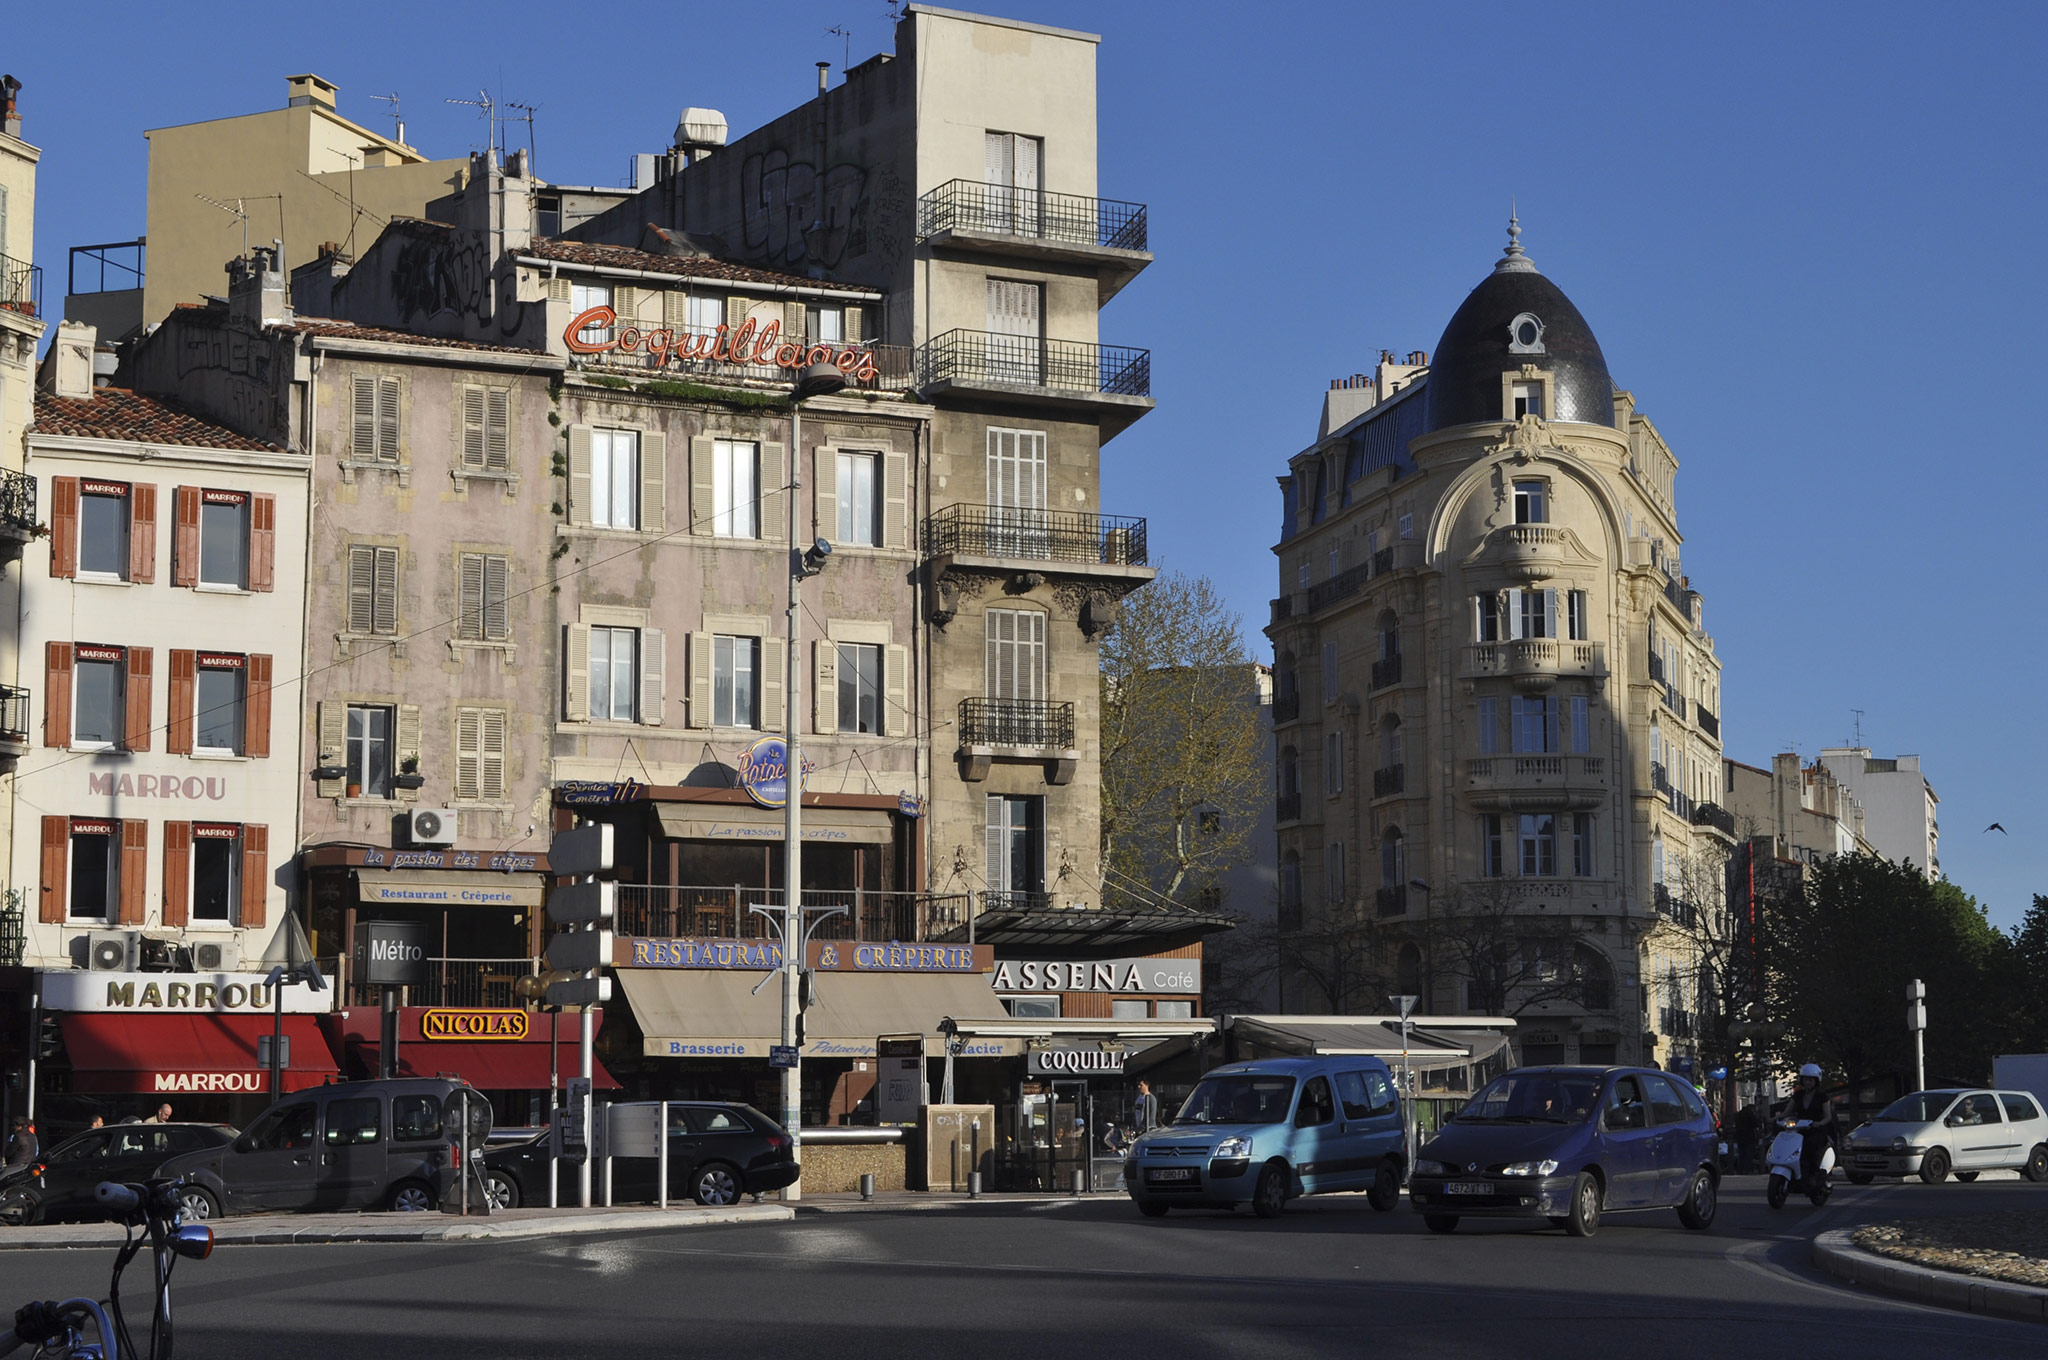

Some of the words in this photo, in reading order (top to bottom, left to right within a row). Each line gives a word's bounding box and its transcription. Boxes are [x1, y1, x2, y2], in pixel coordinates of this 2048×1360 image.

[562, 304, 880, 382] Coquillages
[85, 482, 125, 495] MARROU
[206, 491, 243, 503] MARROU
[79, 649, 119, 660] MARROU
[202, 656, 241, 667] MARROU
[89, 772, 226, 800] MARROU
[613, 778, 640, 801] 7/7
[74, 824, 114, 834] MARROU
[197, 828, 236, 838] MARROU
[709, 823, 732, 837] La
[736, 826, 782, 838] passion
[808, 828, 847, 840] crêpes
[365, 849, 384, 864] La
[392, 851, 443, 869] passion
[454, 851, 479, 866] des
[489, 852, 536, 873] crêpes
[381, 888, 448, 900] Restaurant
[461, 890, 512, 903] Crêperie
[372, 939, 422, 961] Métro
[635, 942, 783, 966] RESTAURAN
[821, 946, 839, 967] &
[854, 942, 973, 969] CRÊPERIE
[991, 961, 1146, 990] ASSENA
[1154, 971, 1194, 989] Café
[106, 981, 273, 1009] MARROU
[430, 1015, 524, 1035] NICOLAS
[669, 1041, 745, 1055] Brasserie
[809, 1041, 878, 1054] Patacrêp
[1039, 1050, 1139, 1073] COQUILLA
[155, 1073, 260, 1092] MARROU
[1483, 1184, 1493, 1193] 13
